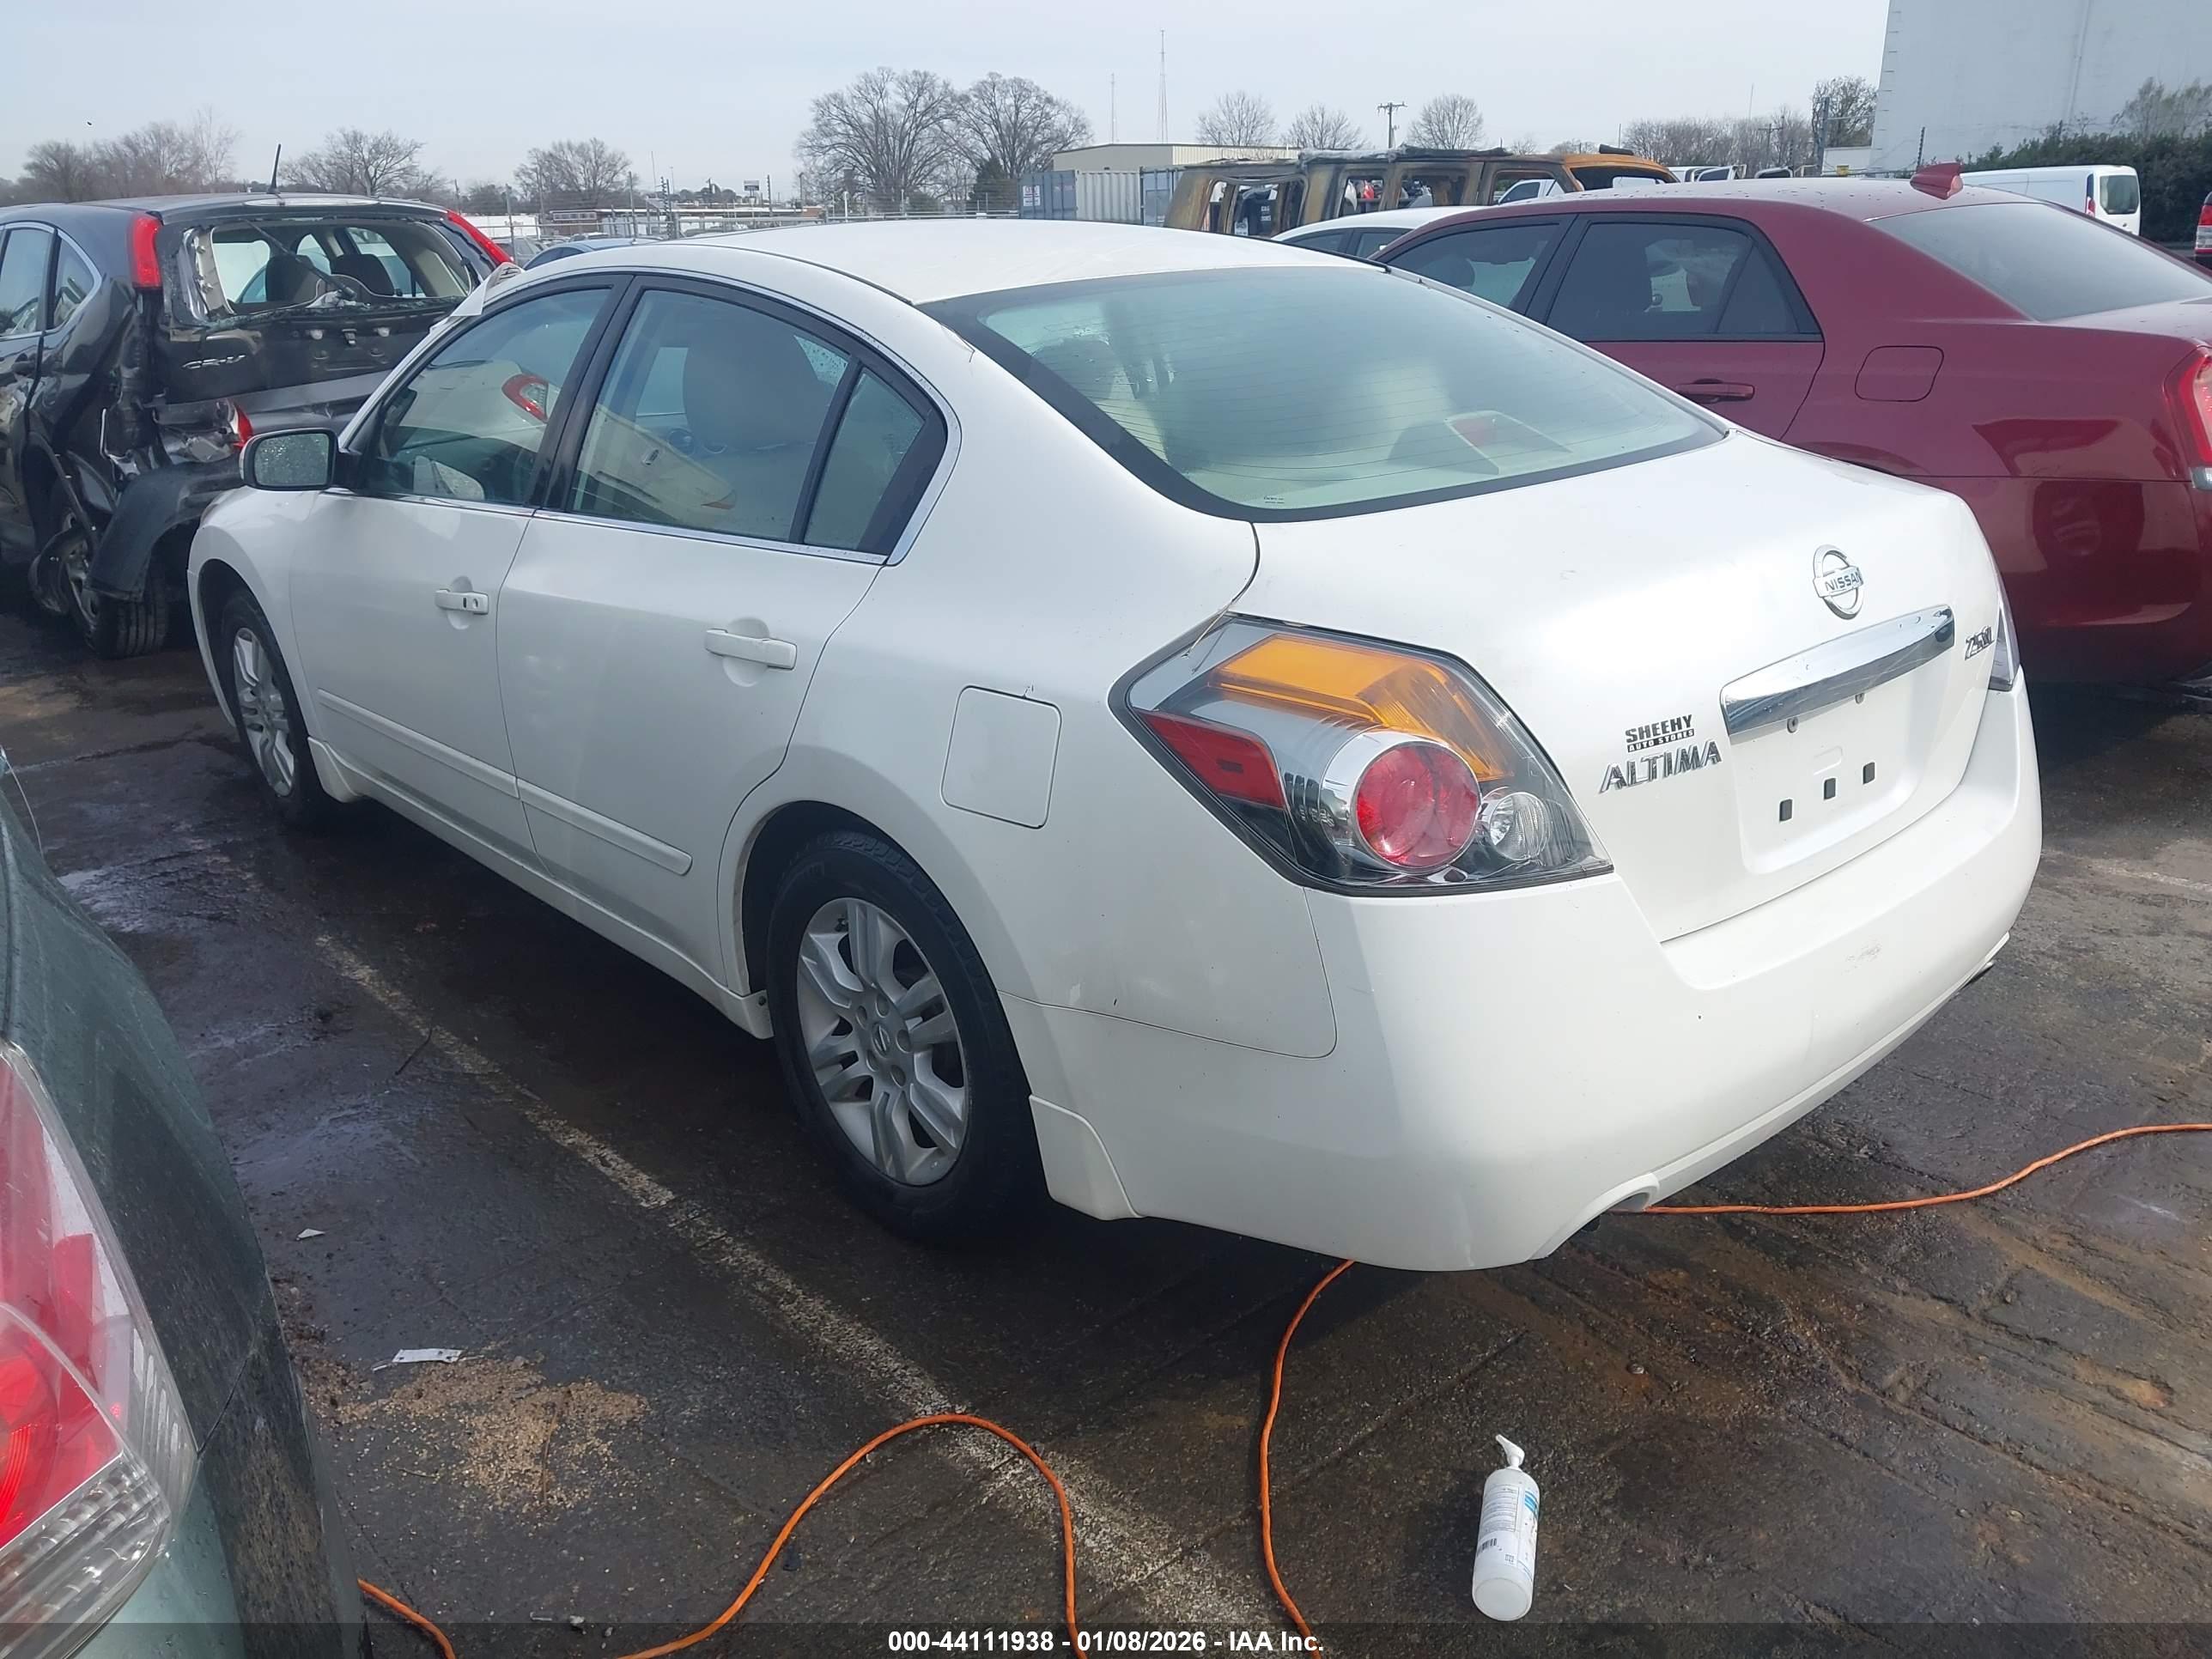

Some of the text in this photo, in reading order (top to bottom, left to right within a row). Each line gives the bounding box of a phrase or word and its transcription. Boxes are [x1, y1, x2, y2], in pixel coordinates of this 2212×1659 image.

[1825, 570, 1862, 592] NISSAN
[1625, 714, 1692, 744] SHEEHY
[1627, 728, 1695, 753] AUTO STORES
[1598, 738, 1723, 794] ALTIMA
